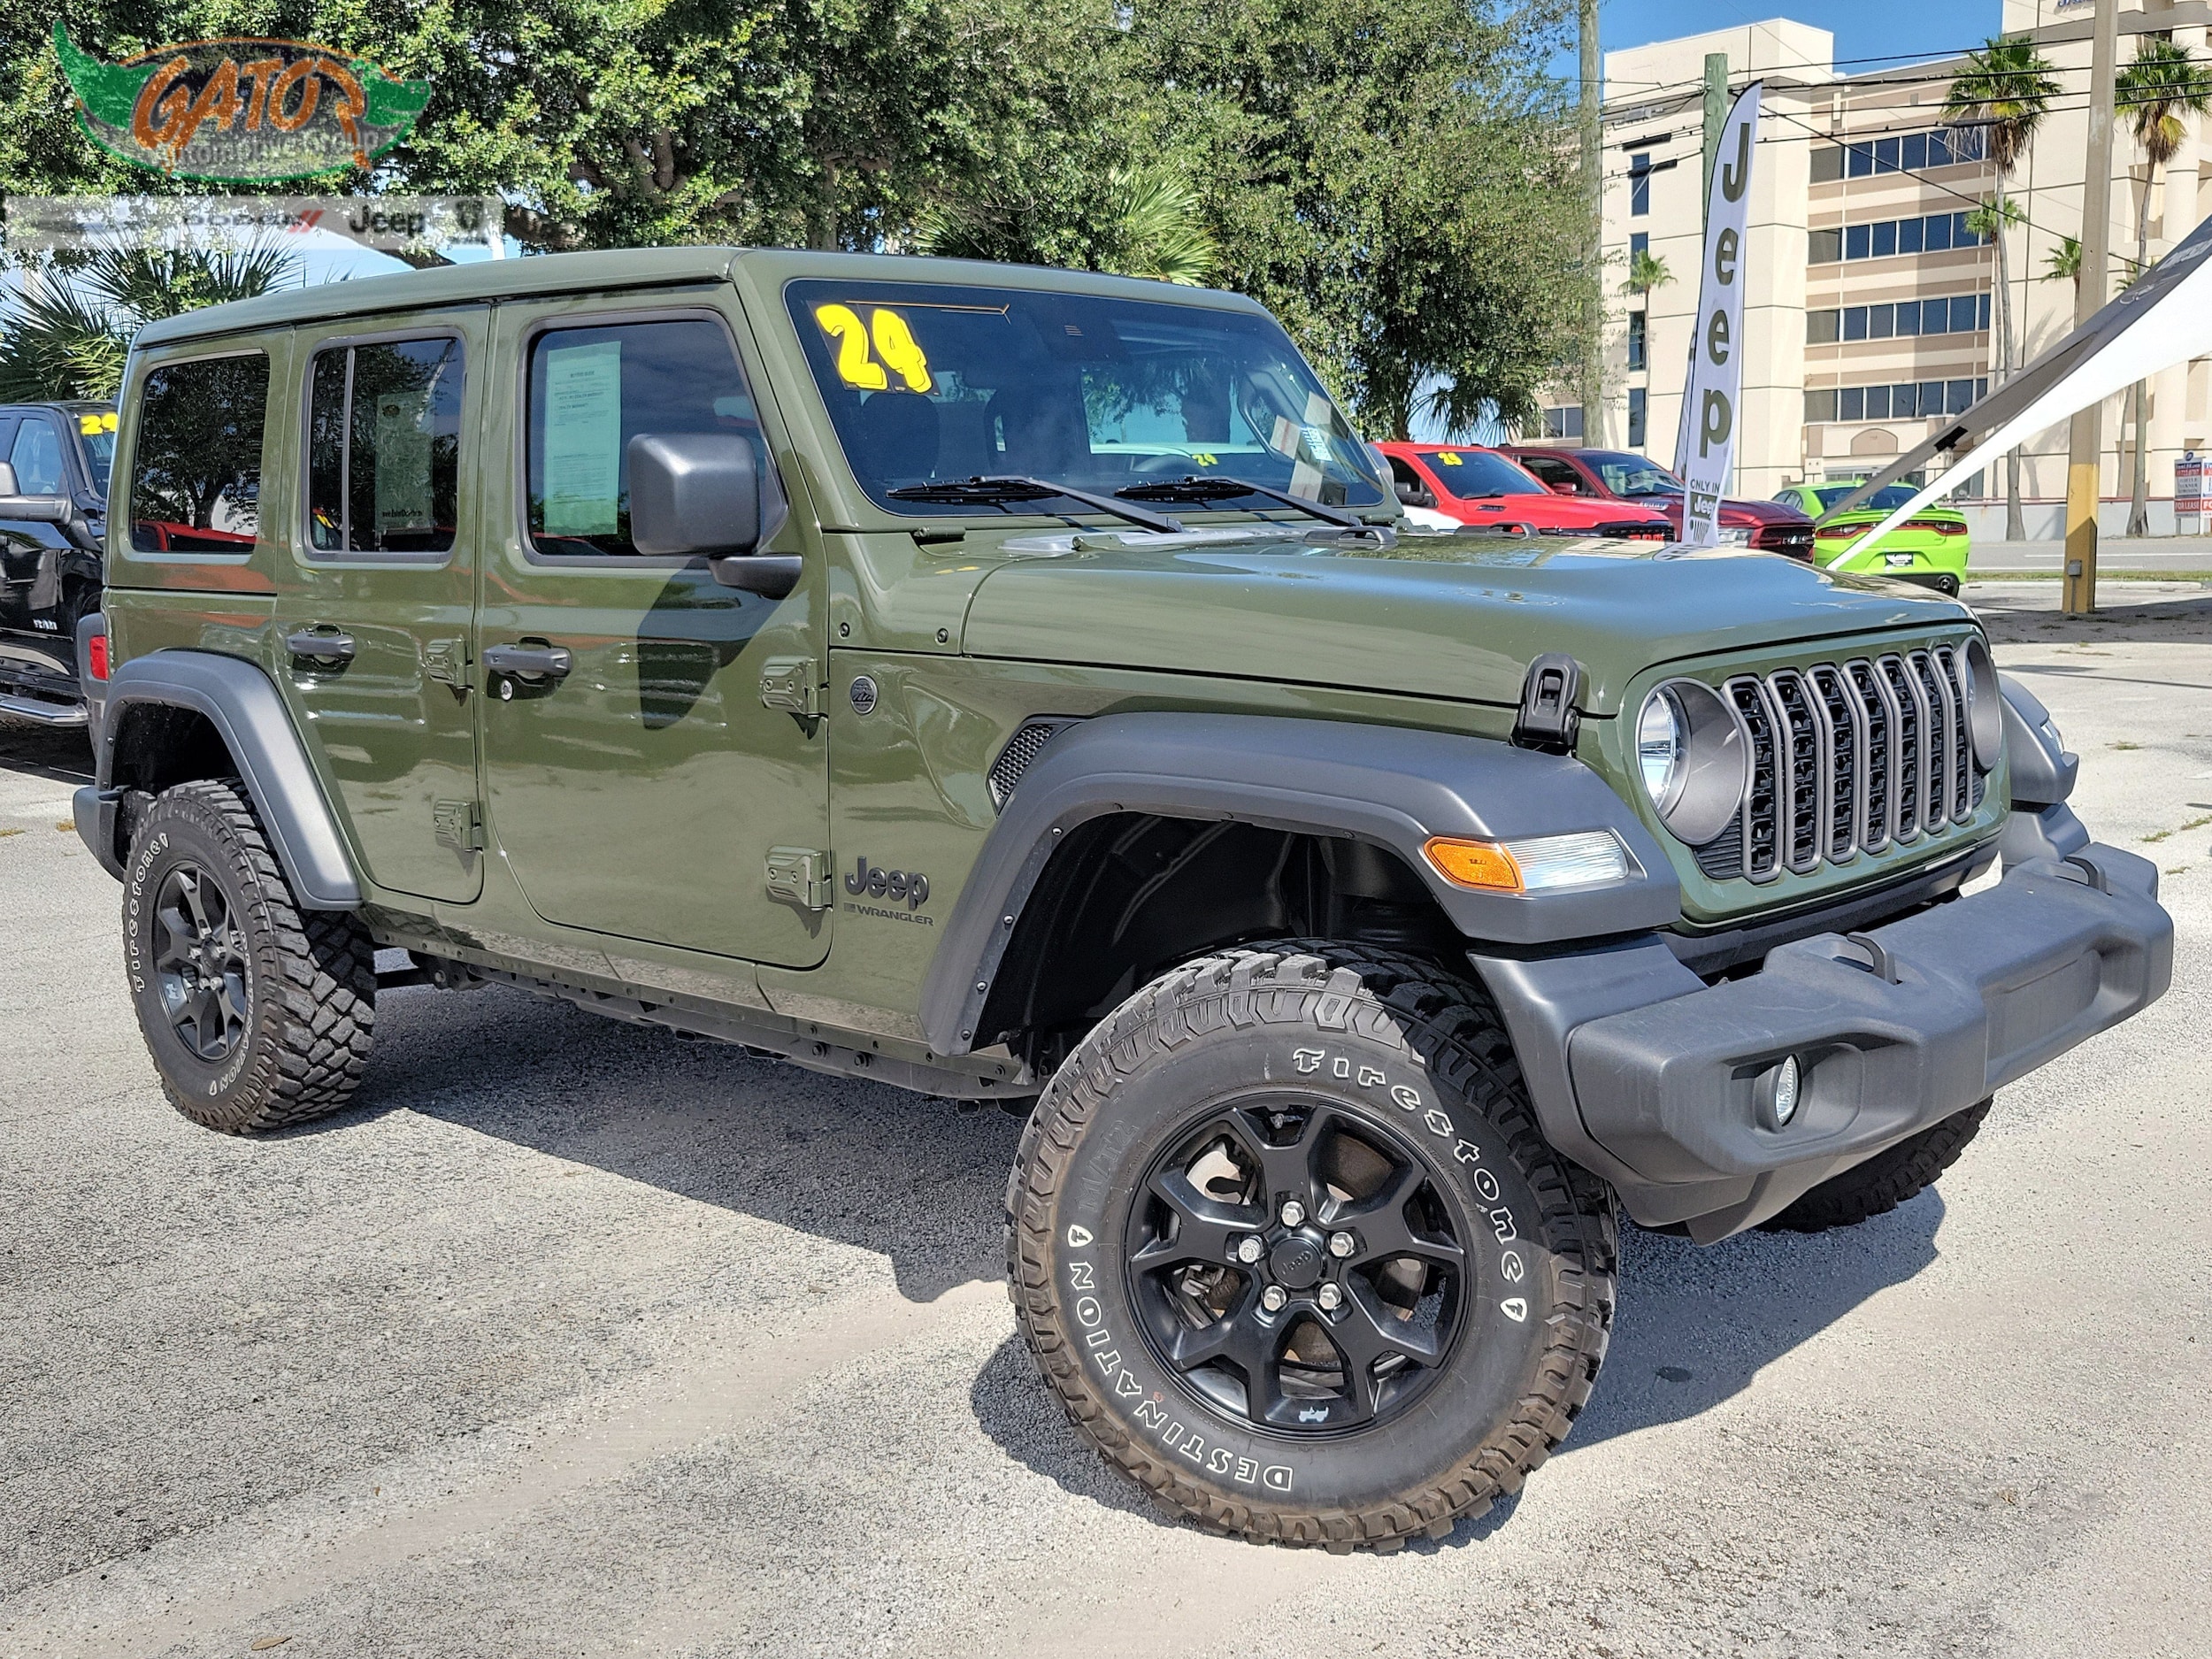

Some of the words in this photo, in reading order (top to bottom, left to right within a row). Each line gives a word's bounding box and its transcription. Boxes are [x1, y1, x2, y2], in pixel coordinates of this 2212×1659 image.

[1699, 122, 1750, 459] Jeep
[816, 303, 933, 394] 24
[1690, 479, 1709, 491] ONLY
[1711, 482, 1721, 493] IN
[844, 856, 930, 912] Jeep
[856, 904, 934, 927] WRANGLER
[1292, 1048, 1525, 1283] Firestone
[1068, 1261, 1294, 1492] DESTINATION
